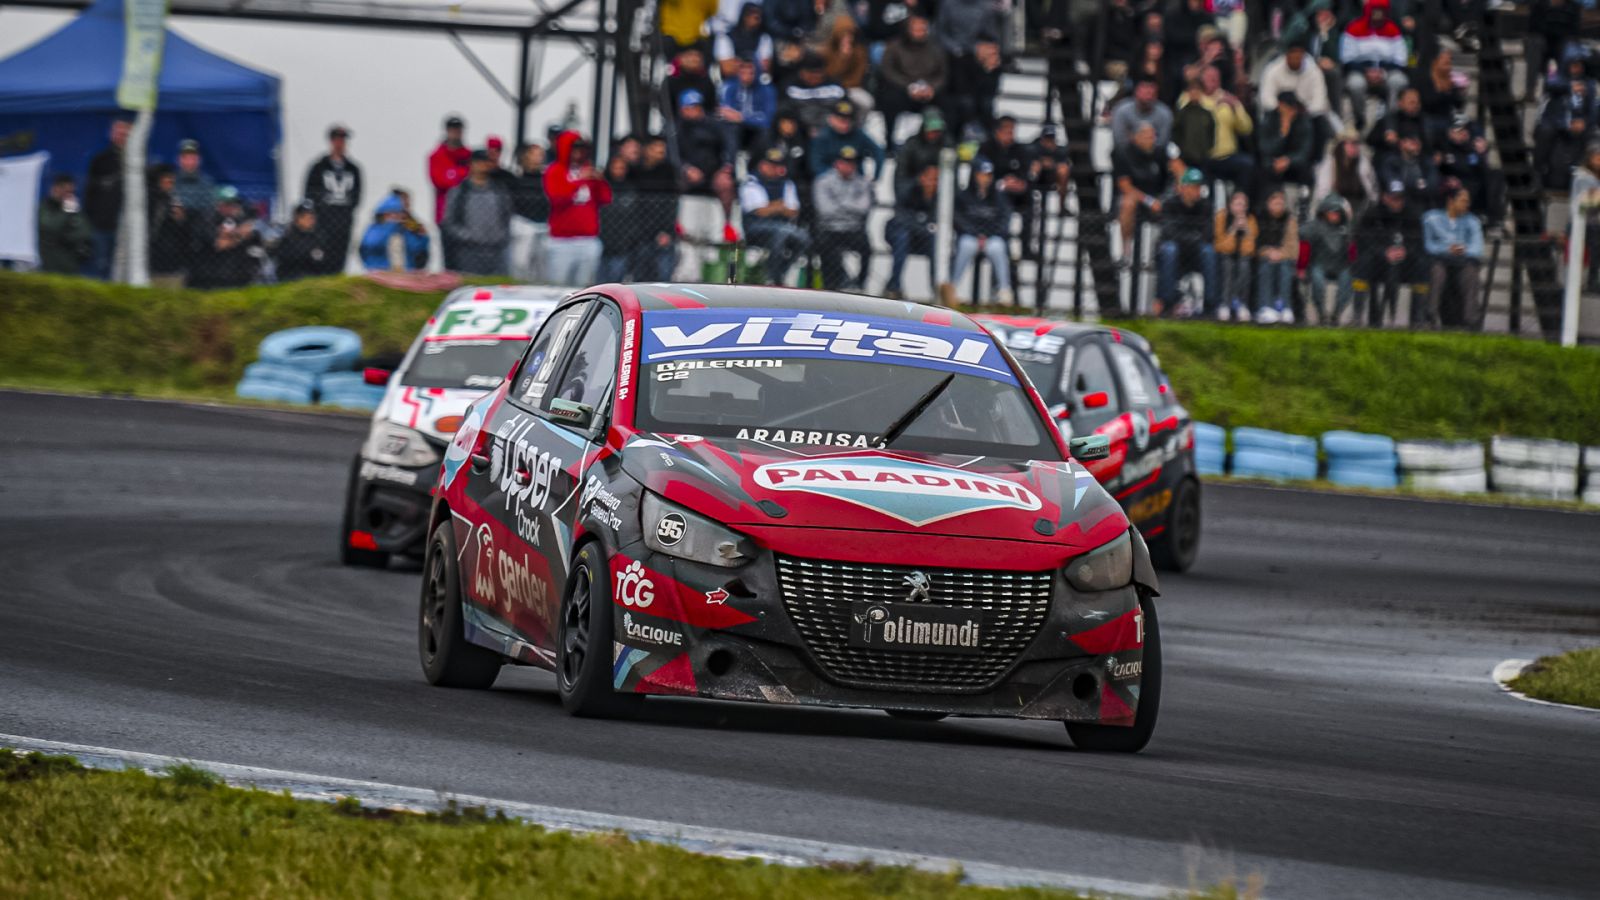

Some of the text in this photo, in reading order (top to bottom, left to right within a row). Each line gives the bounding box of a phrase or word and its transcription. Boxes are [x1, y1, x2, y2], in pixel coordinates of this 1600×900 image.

[651, 313, 989, 364] vittal
[656, 359, 783, 373] BALERINI
[656, 371, 690, 382] C2
[766, 469, 1032, 505] PALADINI
[517, 508, 541, 547] Crock
[658, 518, 684, 539] 95
[616, 570, 655, 608] TCG
[626, 622, 683, 646] CACIQUE
